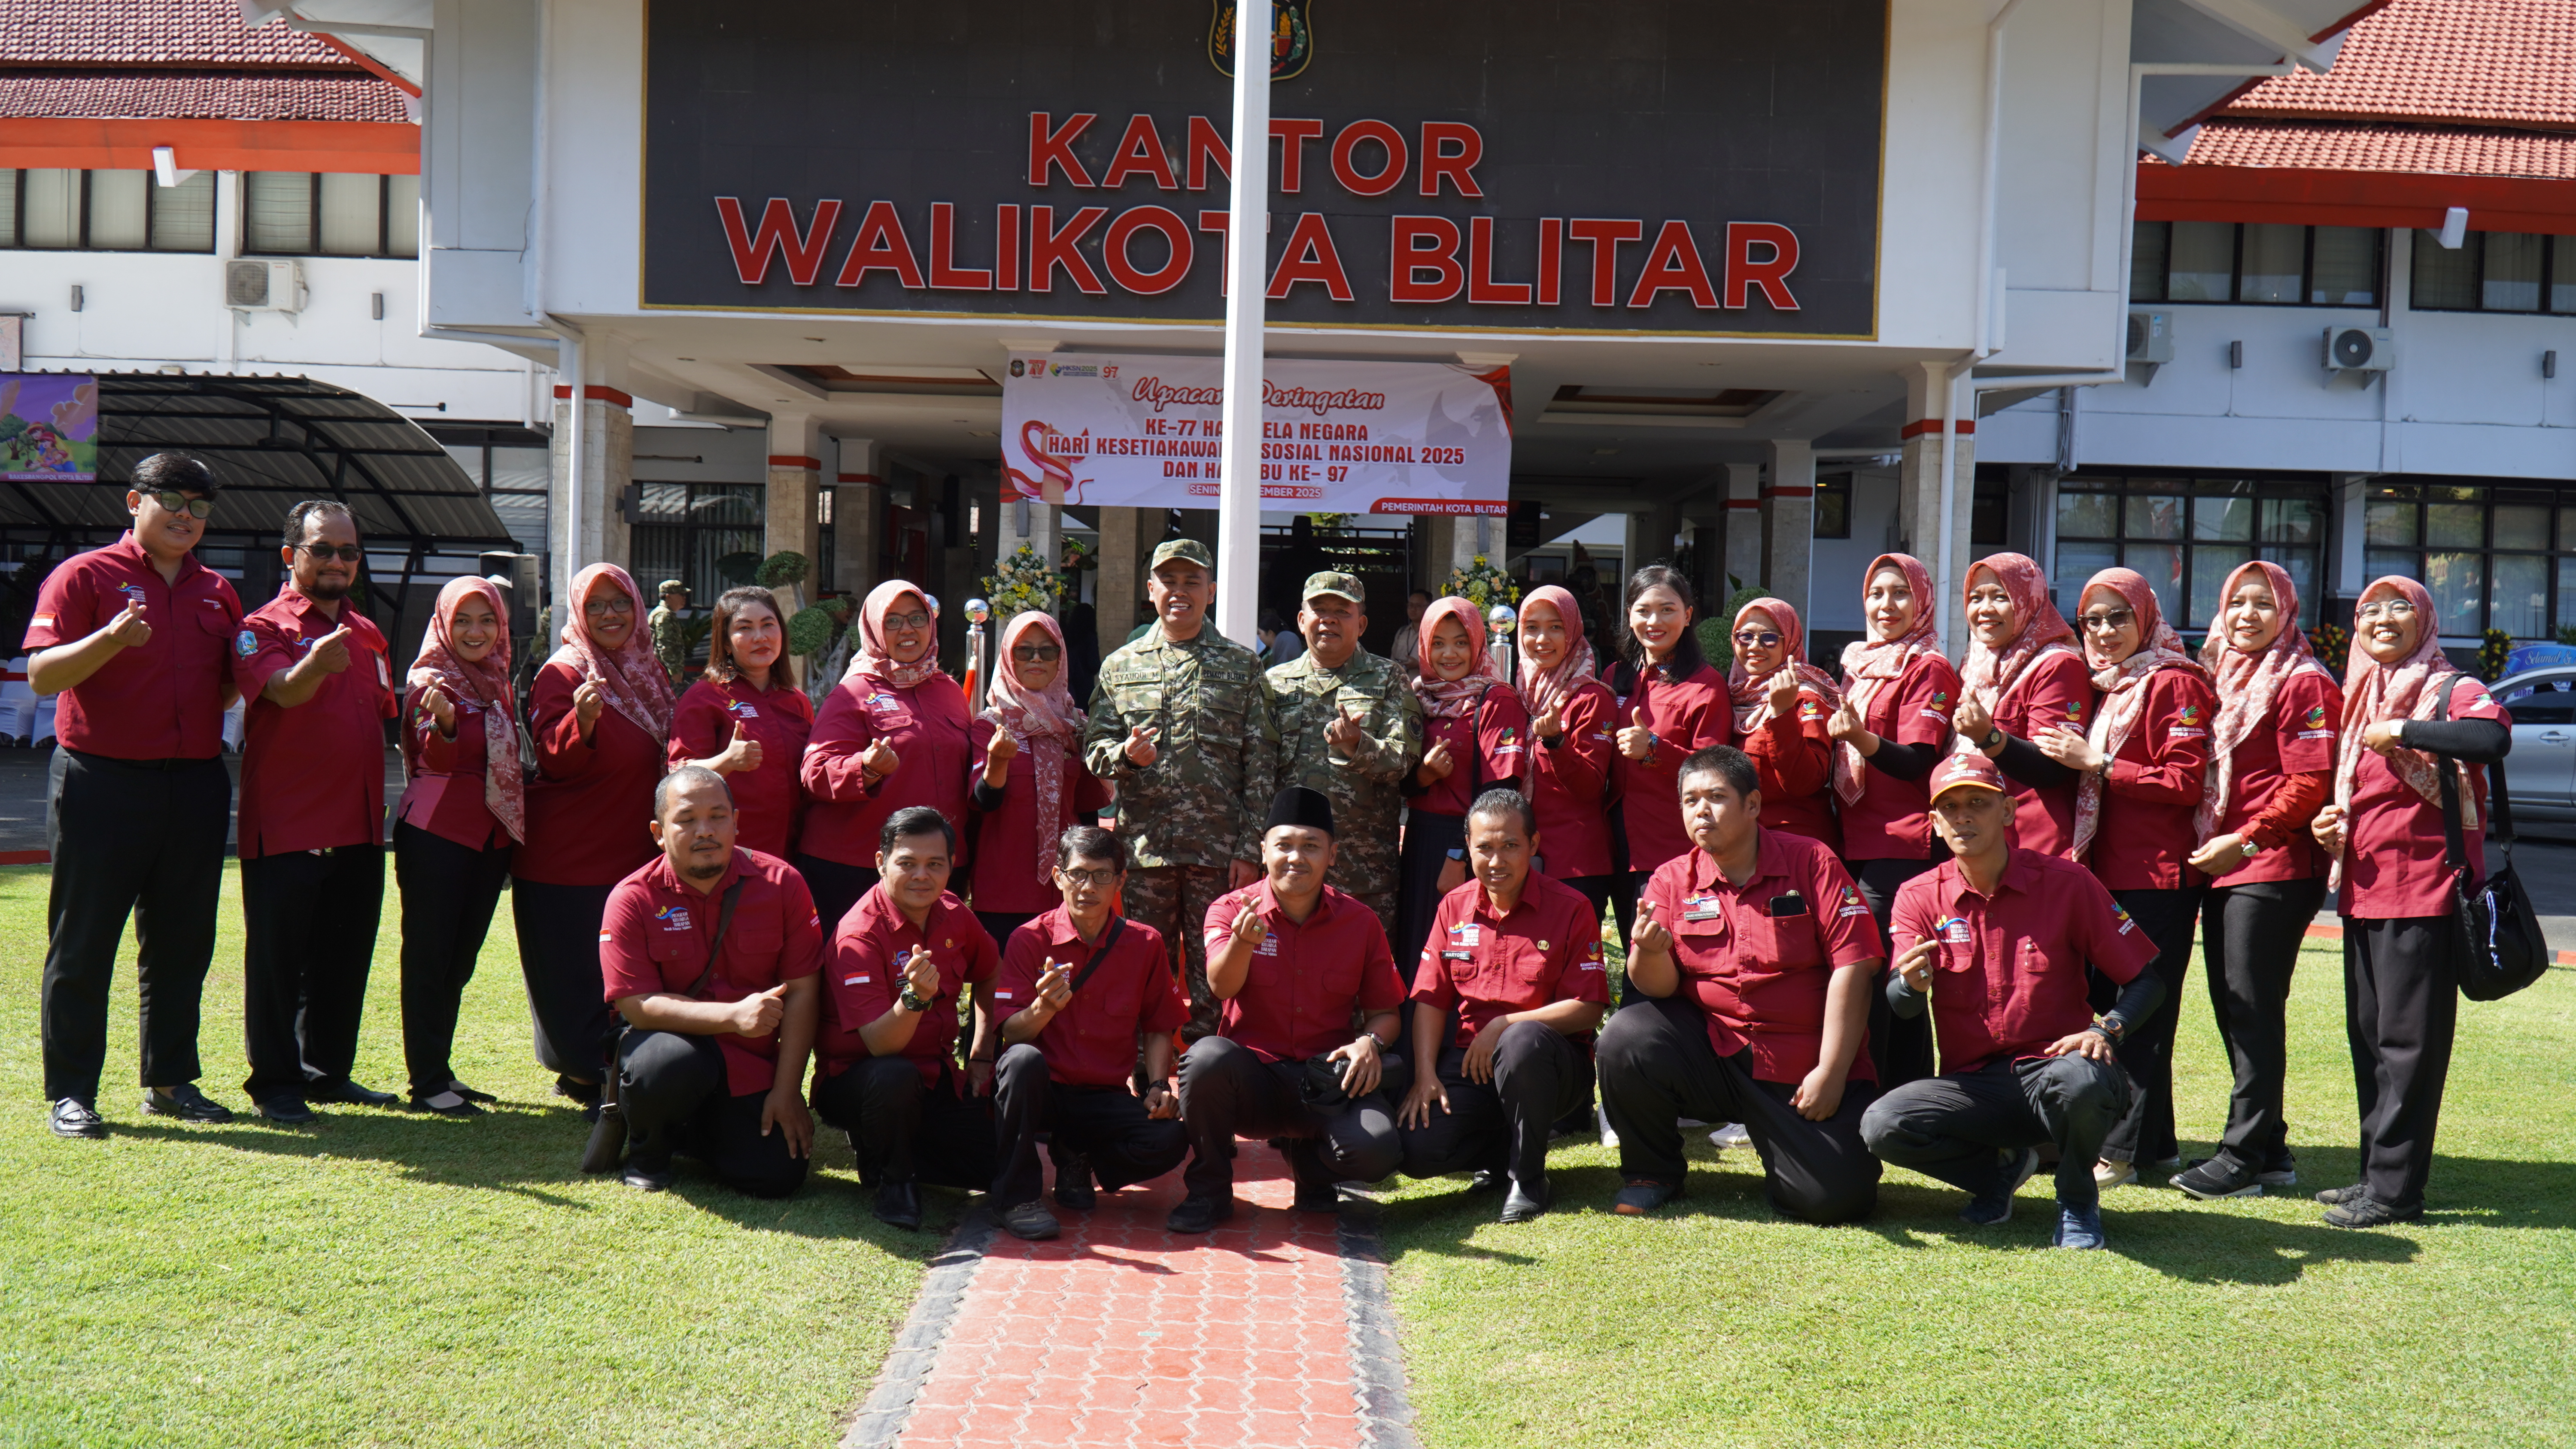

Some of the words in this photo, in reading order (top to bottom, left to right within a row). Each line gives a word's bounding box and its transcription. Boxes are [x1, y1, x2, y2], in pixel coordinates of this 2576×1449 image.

[1029, 111, 1484, 197] KANTOR
[1390, 215, 1801, 310] BLITAR
[1103, 366, 1119, 378] 97
[1133, 377, 1224, 412] Upacar
[1145, 418, 1197, 436] KE-77
[1263, 422, 1293, 440] ELA
[1300, 424, 1368, 441] NEGARA
[1048, 437, 1090, 454] HARI
[1097, 438, 1222, 458] KESETIAKAWA
[1261, 442, 1323, 461] SOSIAL
[1329, 445, 1416, 463] NASIONAL
[1421, 447, 1464, 464] 2025
[1163, 461, 1198, 478] DAN
[1261, 464, 1282, 480] BU
[1327, 466, 1349, 482] 97
[1260, 487, 1294, 497] EMBER
[1296, 488, 1322, 498] 2025
[1381, 502, 1443, 512] PEMERINTAH
[1446, 504, 1472, 514] KOTA
[1474, 504, 1508, 515] BLITAR
[2525, 650, 2561, 665] Selamat
[1203, 669, 1225, 679] PEMKOT
[1227, 672, 1246, 682] BLITAR
